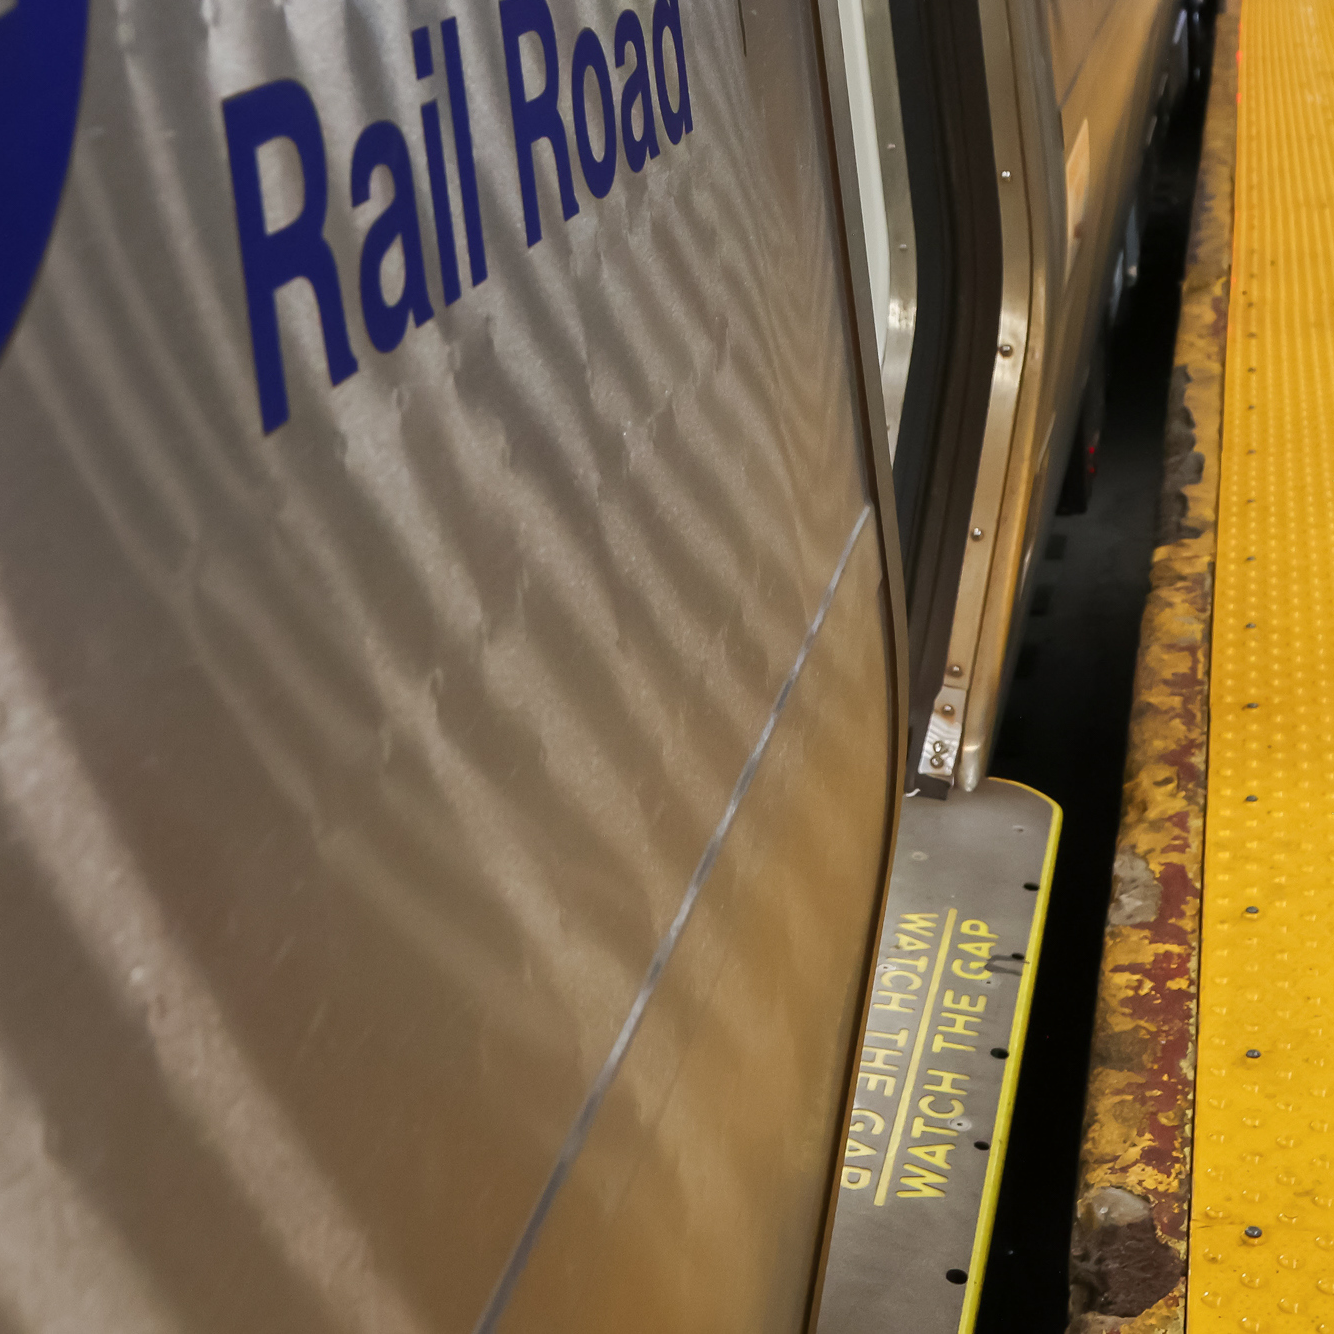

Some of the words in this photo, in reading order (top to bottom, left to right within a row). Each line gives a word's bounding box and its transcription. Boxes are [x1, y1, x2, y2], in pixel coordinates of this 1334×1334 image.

[221, 17, 487, 437] Rail
[873, 912, 939, 1013] WATCH
[951, 918, 999, 981] GAP
[858, 1027, 910, 1097] THE
[932, 989, 988, 1052] THE
[840, 1108, 885, 1191] GAP
[896, 1069, 970, 1199] WATCH
